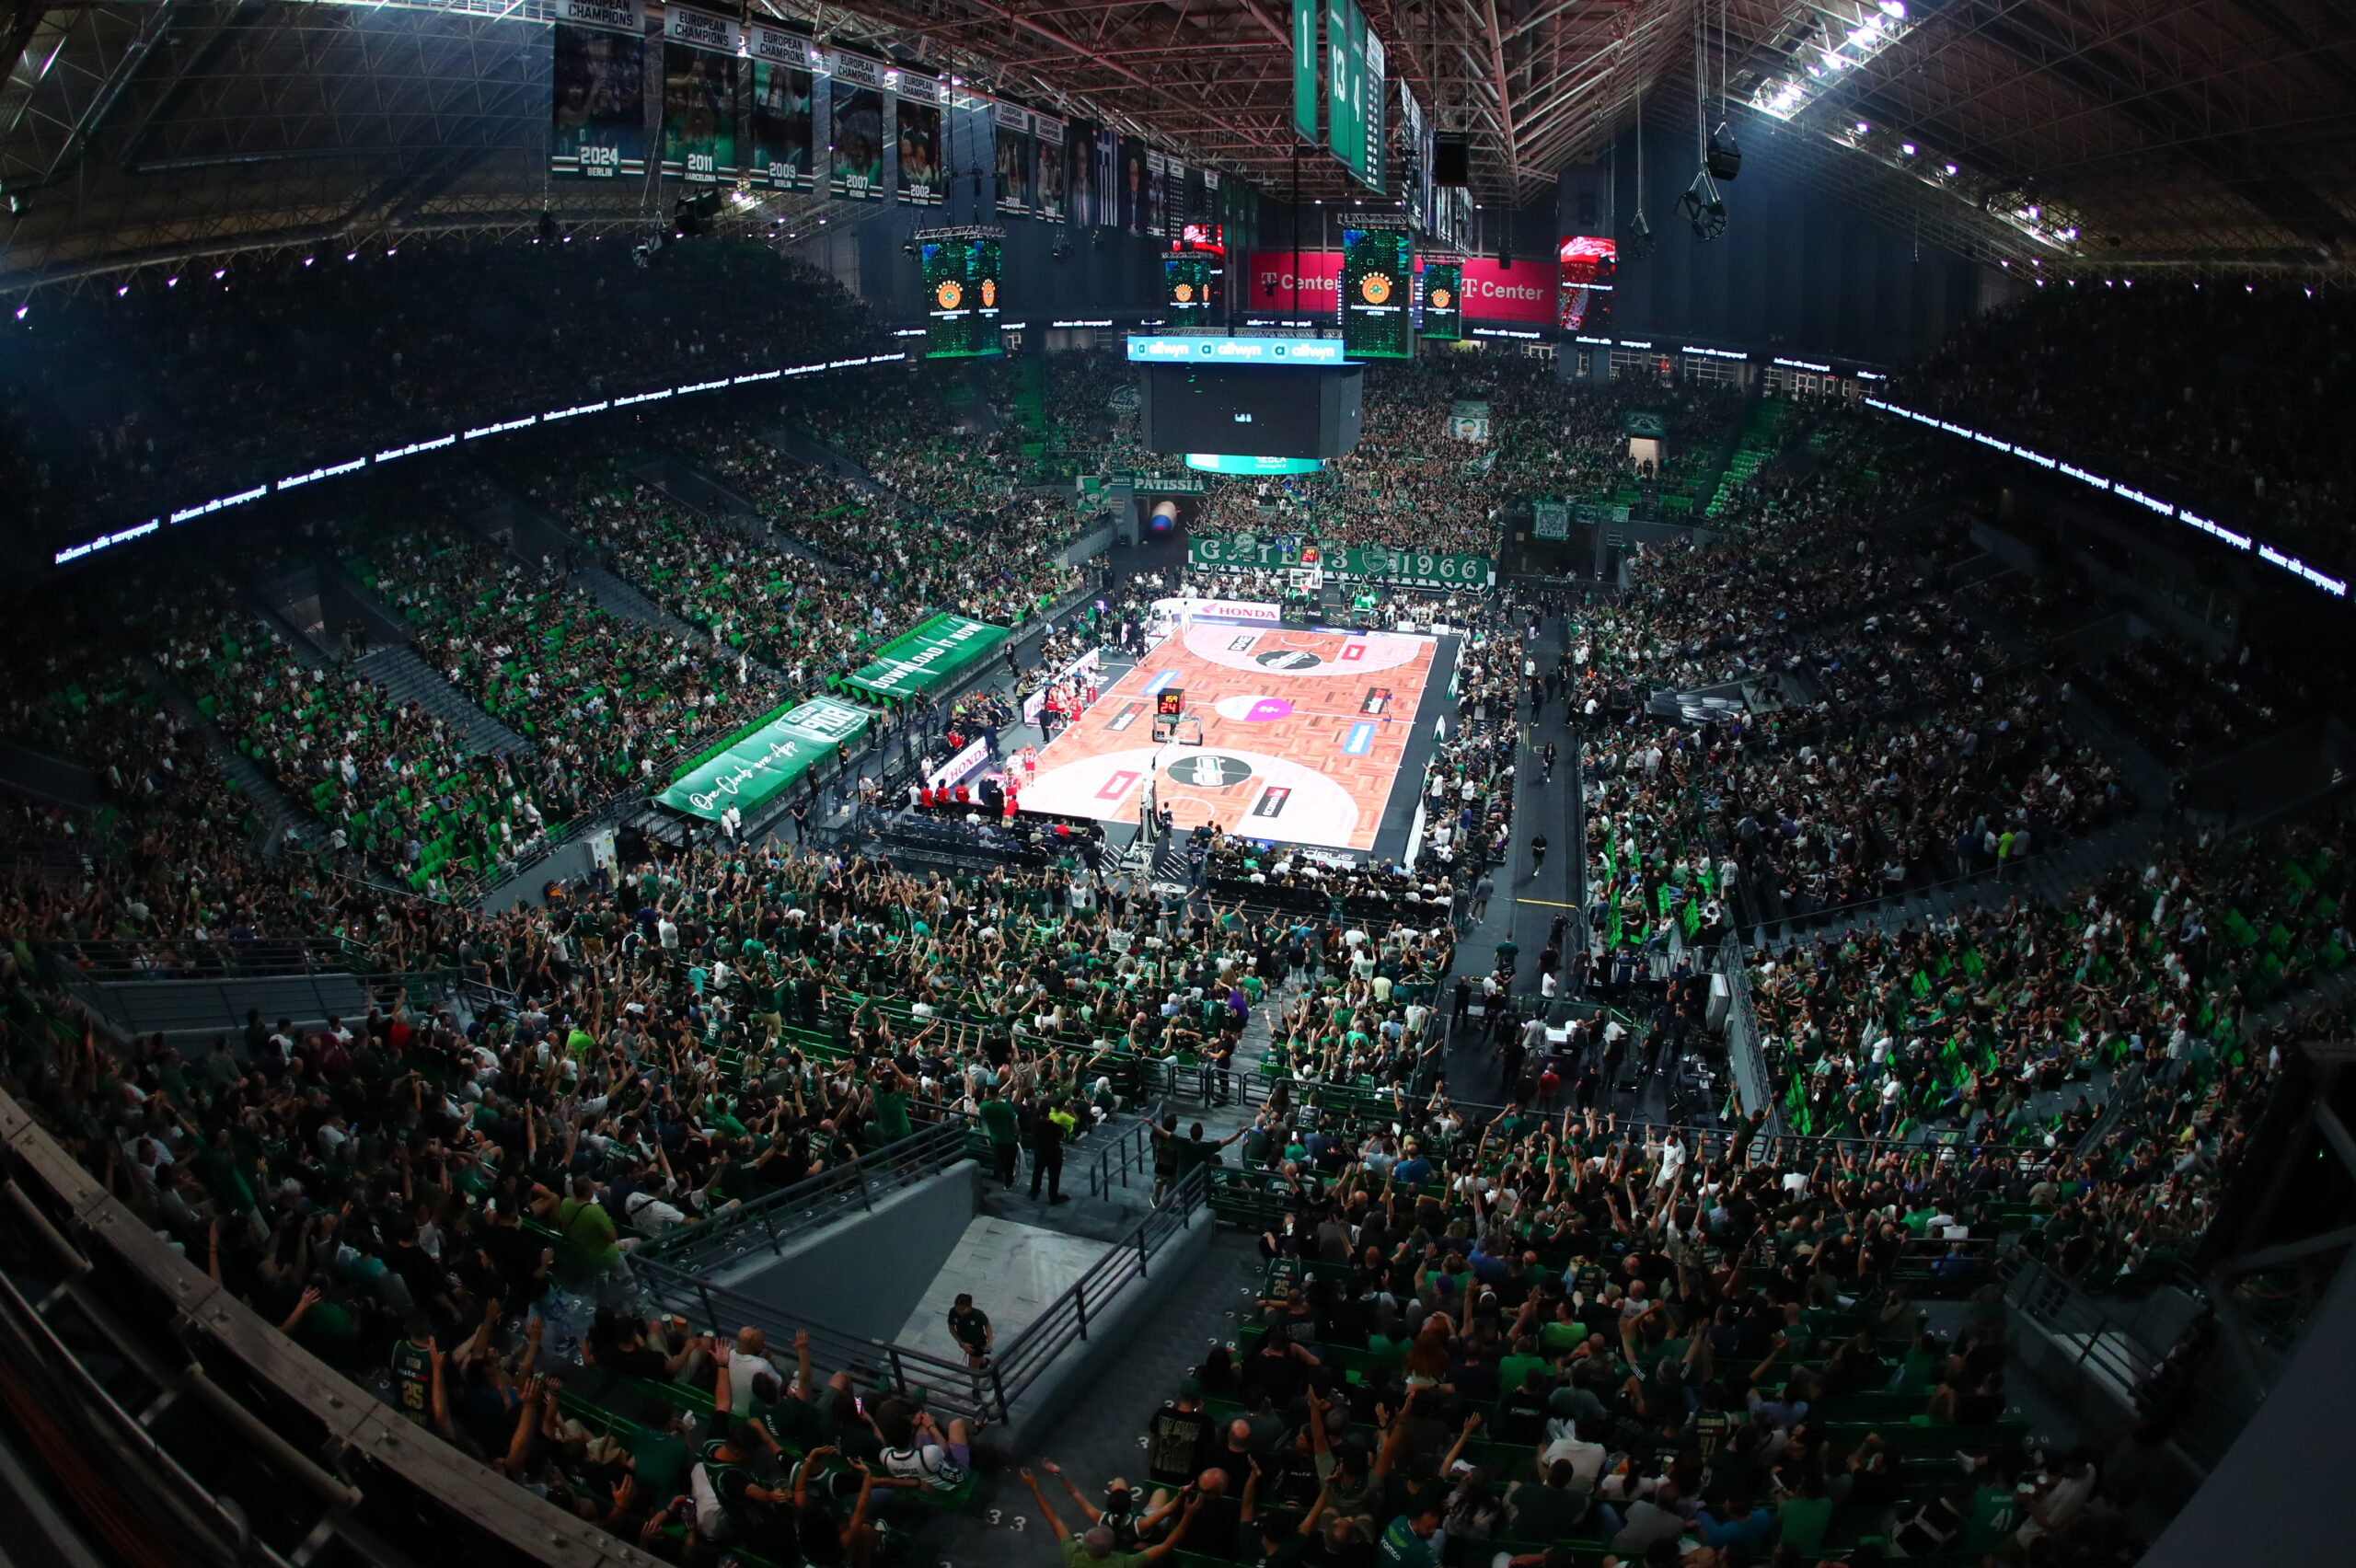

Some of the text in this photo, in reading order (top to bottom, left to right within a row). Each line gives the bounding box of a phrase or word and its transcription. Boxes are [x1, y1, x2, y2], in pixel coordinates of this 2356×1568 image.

[568, 5, 634, 27] CHAMPIONS
[679, 11, 727, 33] EUROPEAN
[675, 24, 729, 46] CHAMPIONS
[763, 31, 803, 51] EUROPEAN
[759, 43, 805, 63] CHAMPIONS
[840, 54, 874, 74] EUROPEAN
[1333, 44, 1345, 102] 13
[837, 65, 876, 85] CHAMPIONS
[904, 75, 933, 91] EUROPEAN
[902, 86, 935, 101] CHAMPIONS
[580, 146, 618, 166] 2024
[687, 154, 713, 172] 2011
[587, 167, 613, 177] BERLIN
[685, 173, 717, 182] BARCELONA
[768, 161, 796, 179] 2009
[846, 174, 869, 190] 2007
[910, 184, 930, 198] 2002
[1482, 281, 1544, 301] Center
[1149, 341, 1189, 357] allwyn
[1218, 342, 1262, 359] allwyn
[1291, 344, 1335, 361] allwyn
[1134, 478, 1205, 491] PATISSIA
[1401, 555, 1478, 580] 1966
[1219, 607, 1276, 619] HONDA
[869, 622, 984, 690] DOWNLOAD IT NOW
[787, 706, 818, 723] CLUB
[1160, 702, 1176, 713] 24
[794, 705, 858, 735] 1908
[769, 741, 800, 757] App
[950, 744, 989, 782] HONDA
[1273, 1278, 1290, 1297] 25
[400, 1379, 424, 1411] 25
[1989, 1507, 2013, 1531] 41
